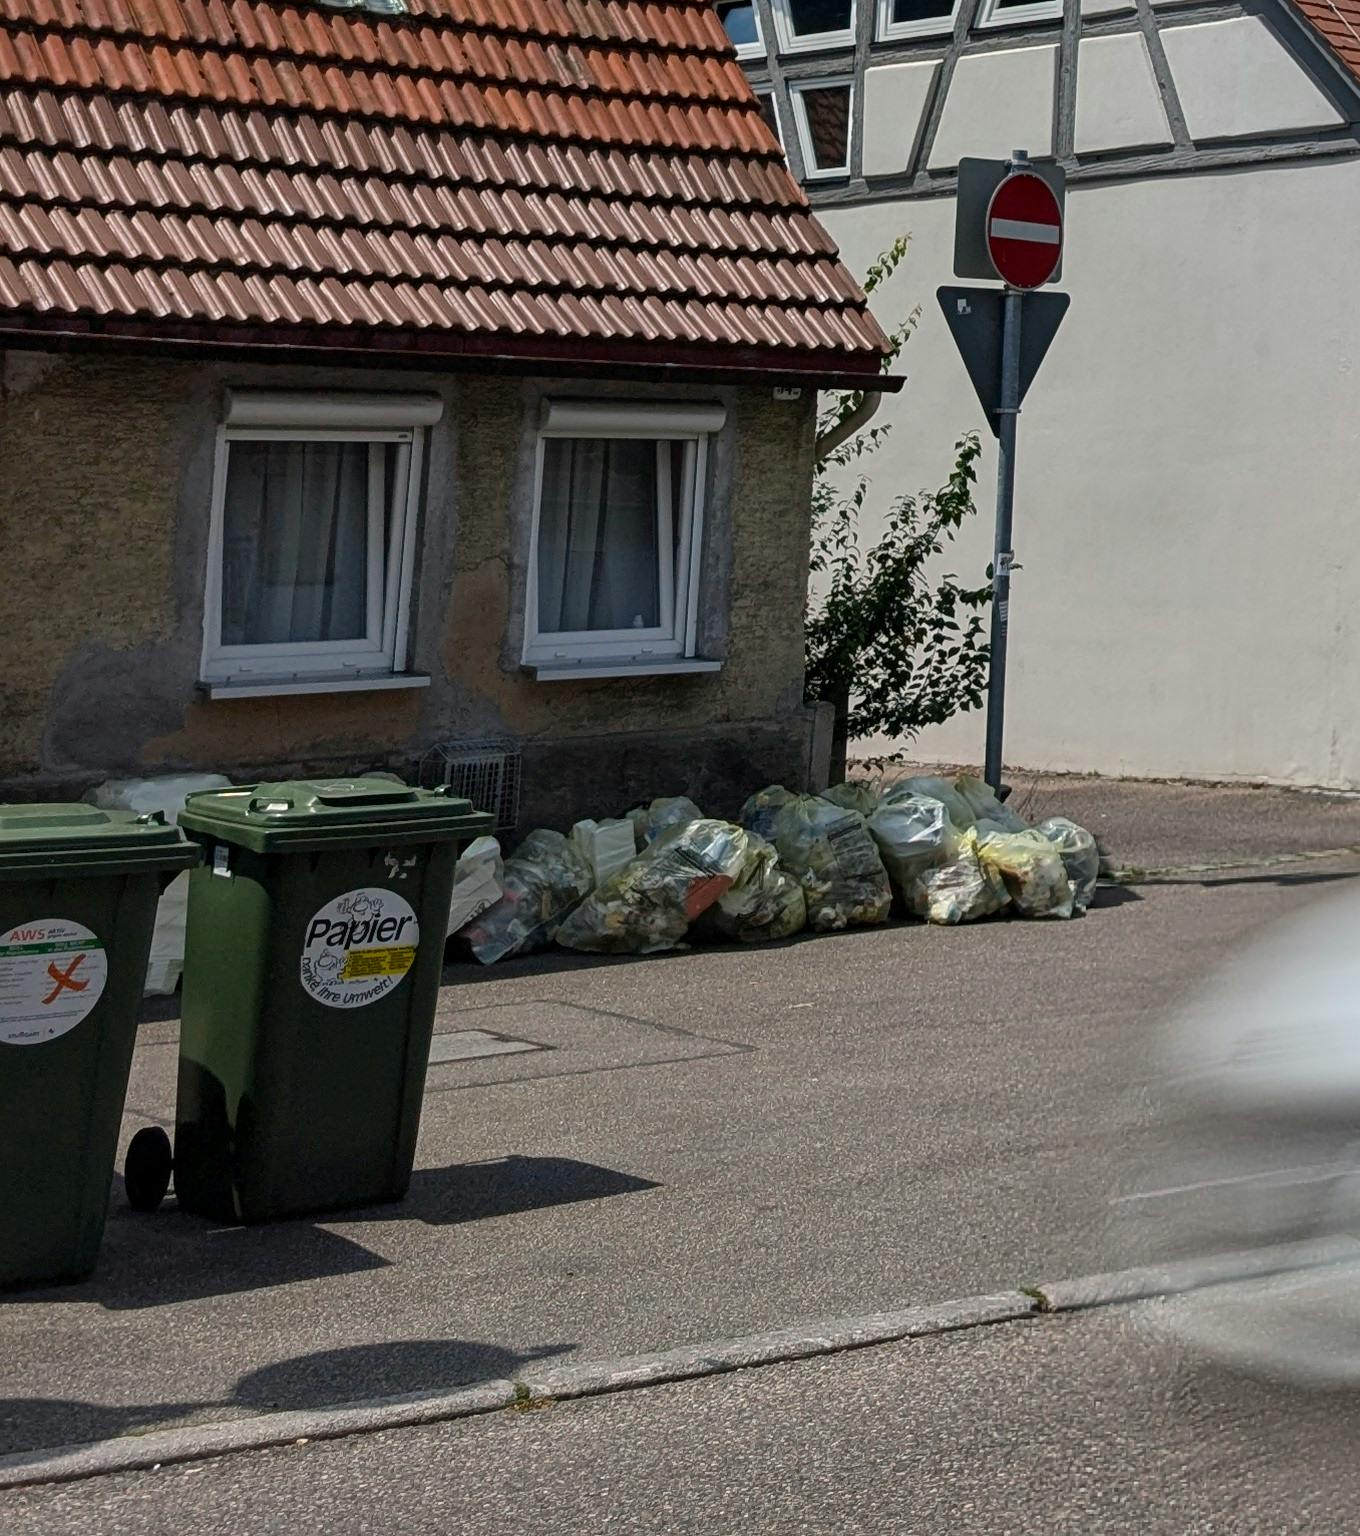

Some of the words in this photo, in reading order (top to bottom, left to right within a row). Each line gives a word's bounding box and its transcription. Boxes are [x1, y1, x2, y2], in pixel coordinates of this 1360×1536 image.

[9, 928, 46, 942] AWS
[306, 913, 412, 950] Papier
[317, 986, 341, 1003] Ihre
